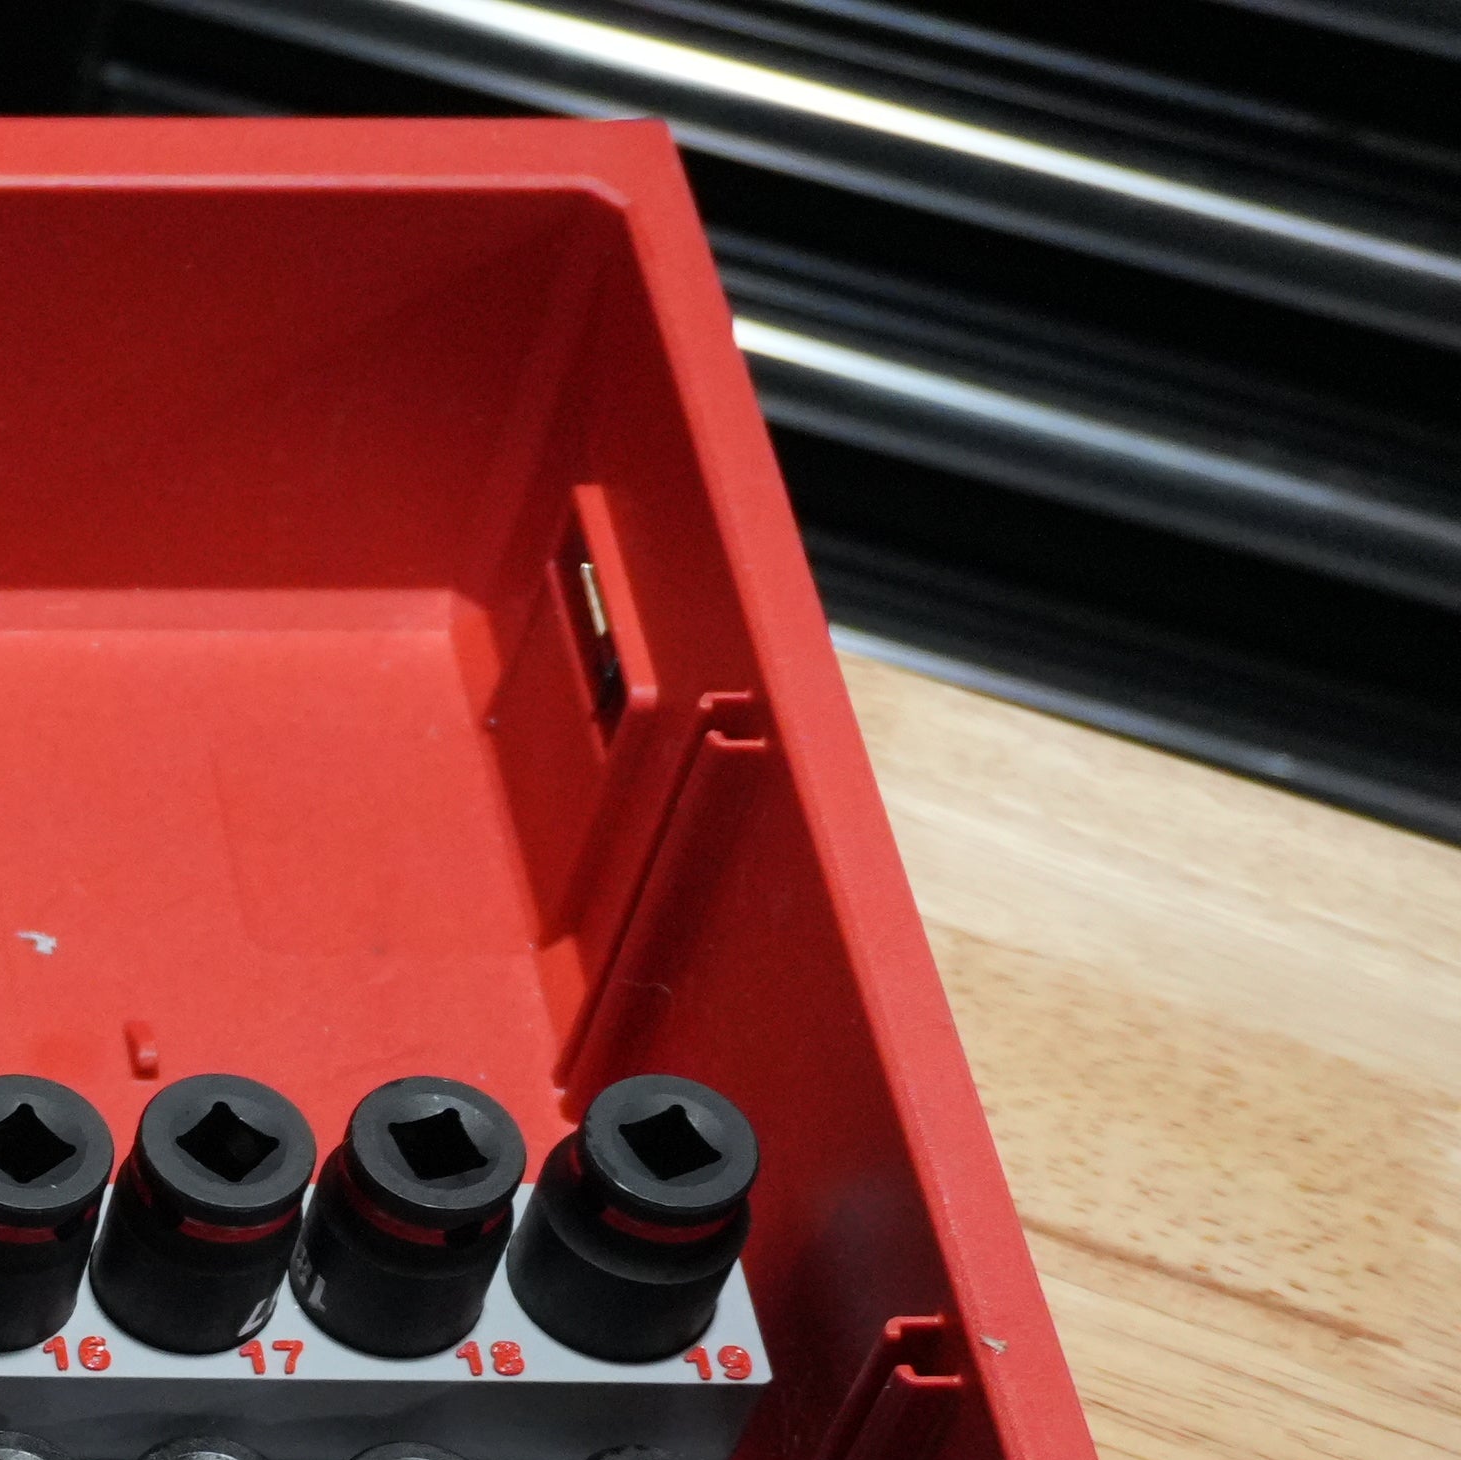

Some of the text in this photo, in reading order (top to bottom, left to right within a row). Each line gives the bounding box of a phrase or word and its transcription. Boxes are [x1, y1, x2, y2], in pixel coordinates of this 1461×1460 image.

[44, 1336, 112, 1371] 16
[240, 1340, 305, 1375] 17
[457, 1341, 526, 1377] 18
[686, 1345, 753, 1380] 19
